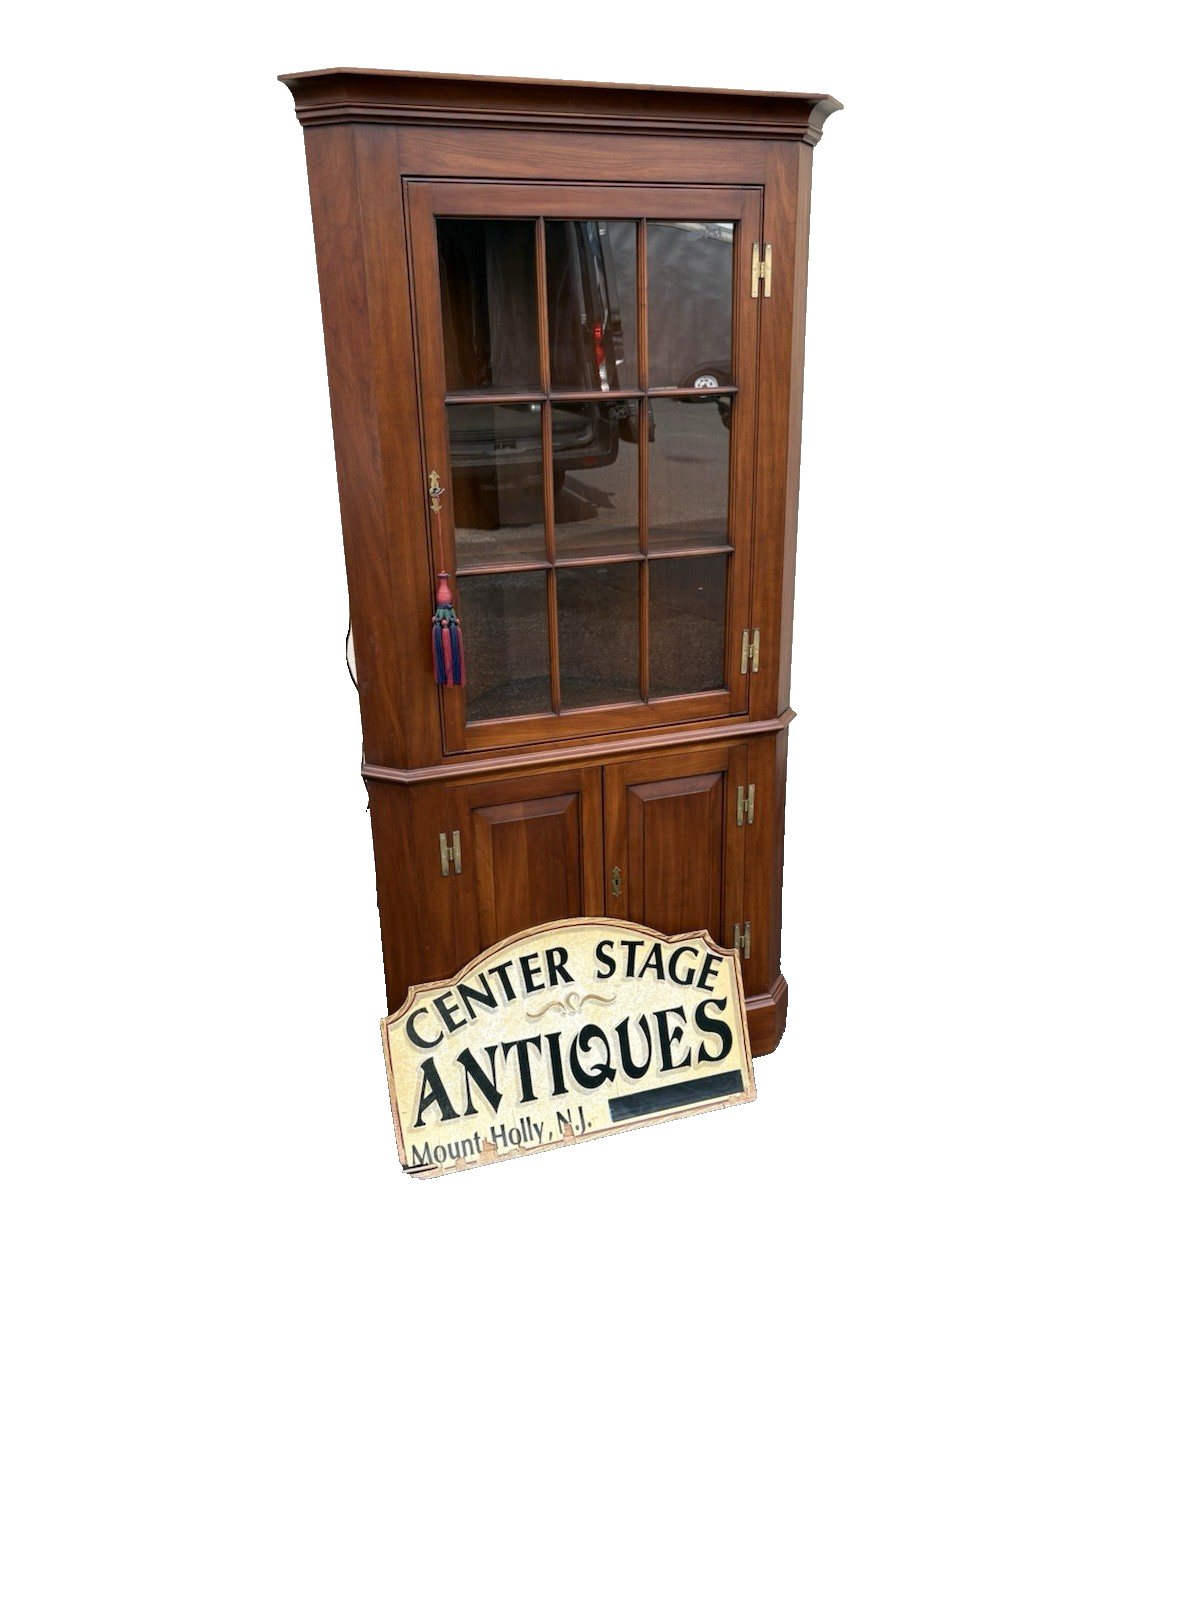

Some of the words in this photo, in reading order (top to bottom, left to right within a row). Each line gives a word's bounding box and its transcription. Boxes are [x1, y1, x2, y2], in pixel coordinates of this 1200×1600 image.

[406, 946, 574, 1048] CENTER
[595, 940, 723, 991] STAGE
[413, 997, 733, 1128] ANTIQUES
[411, 1131, 483, 1166] Mount
[490, 1116, 553, 1148] Holly,
[556, 1106, 592, 1135] N.J.
